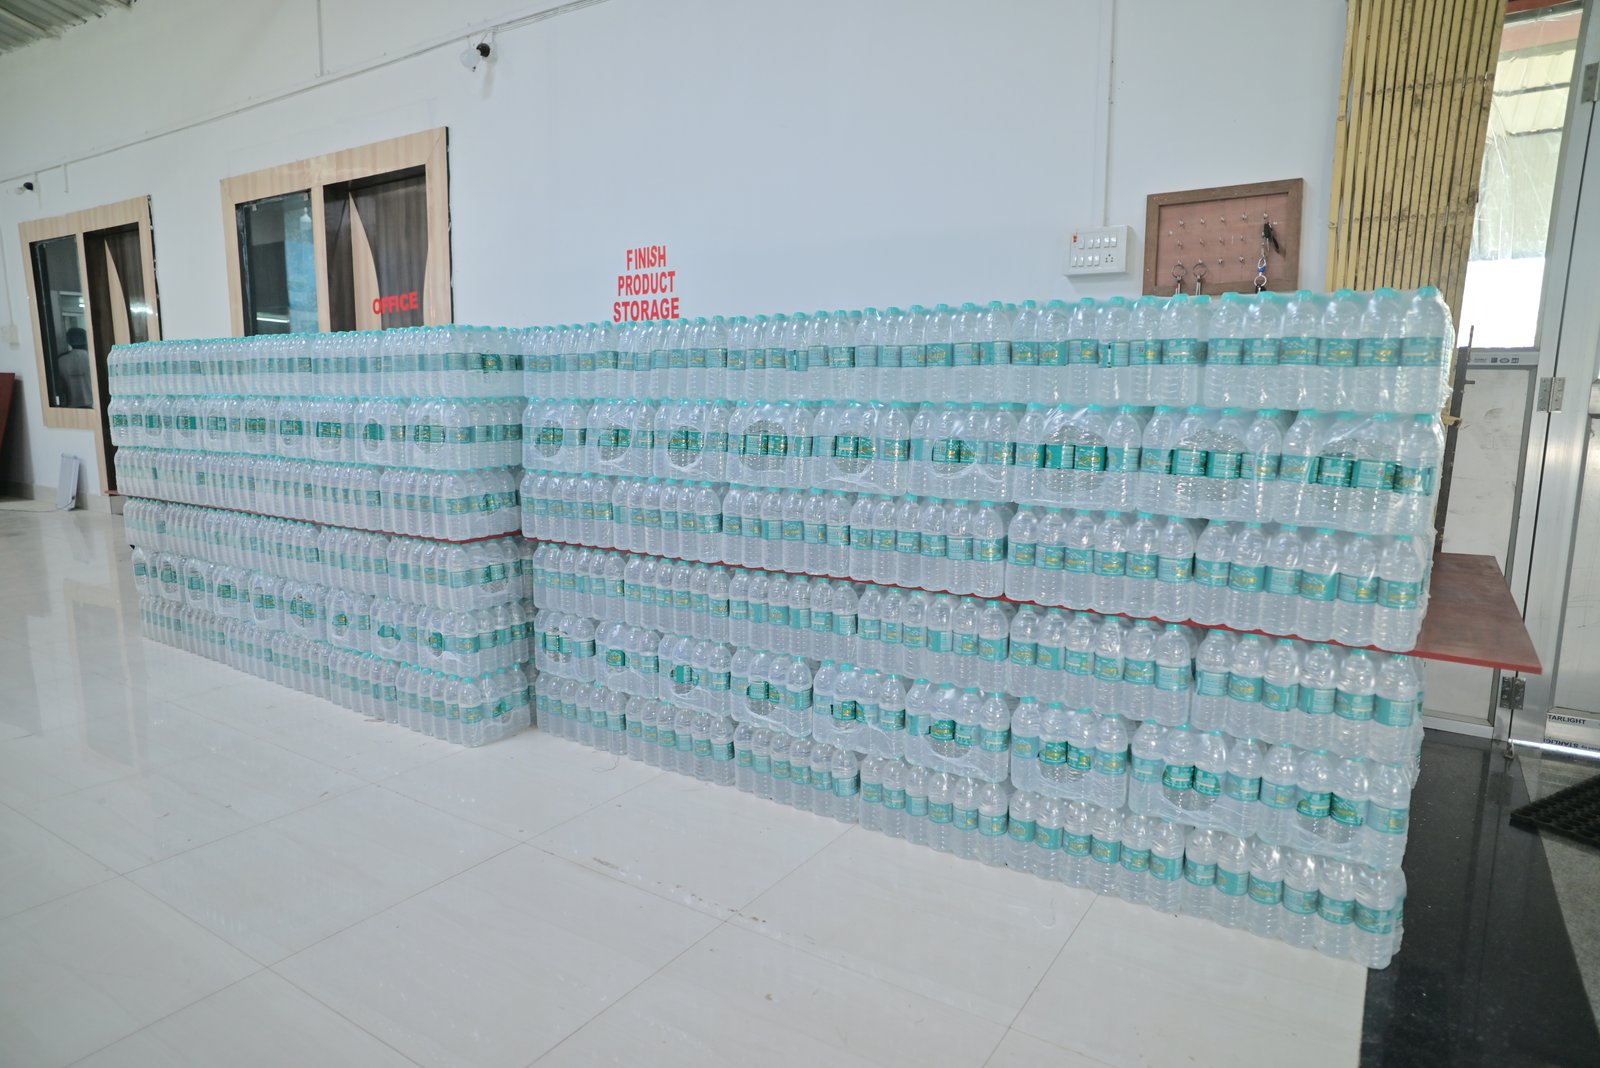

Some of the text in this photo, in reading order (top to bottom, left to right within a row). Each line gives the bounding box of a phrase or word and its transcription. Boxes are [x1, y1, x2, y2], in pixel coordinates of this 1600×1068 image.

[626, 245, 666, 271] FINISH
[618, 271, 675, 296] PRODUCT
[372, 291, 418, 316] OFFICE
[613, 297, 680, 322] STORAGE
